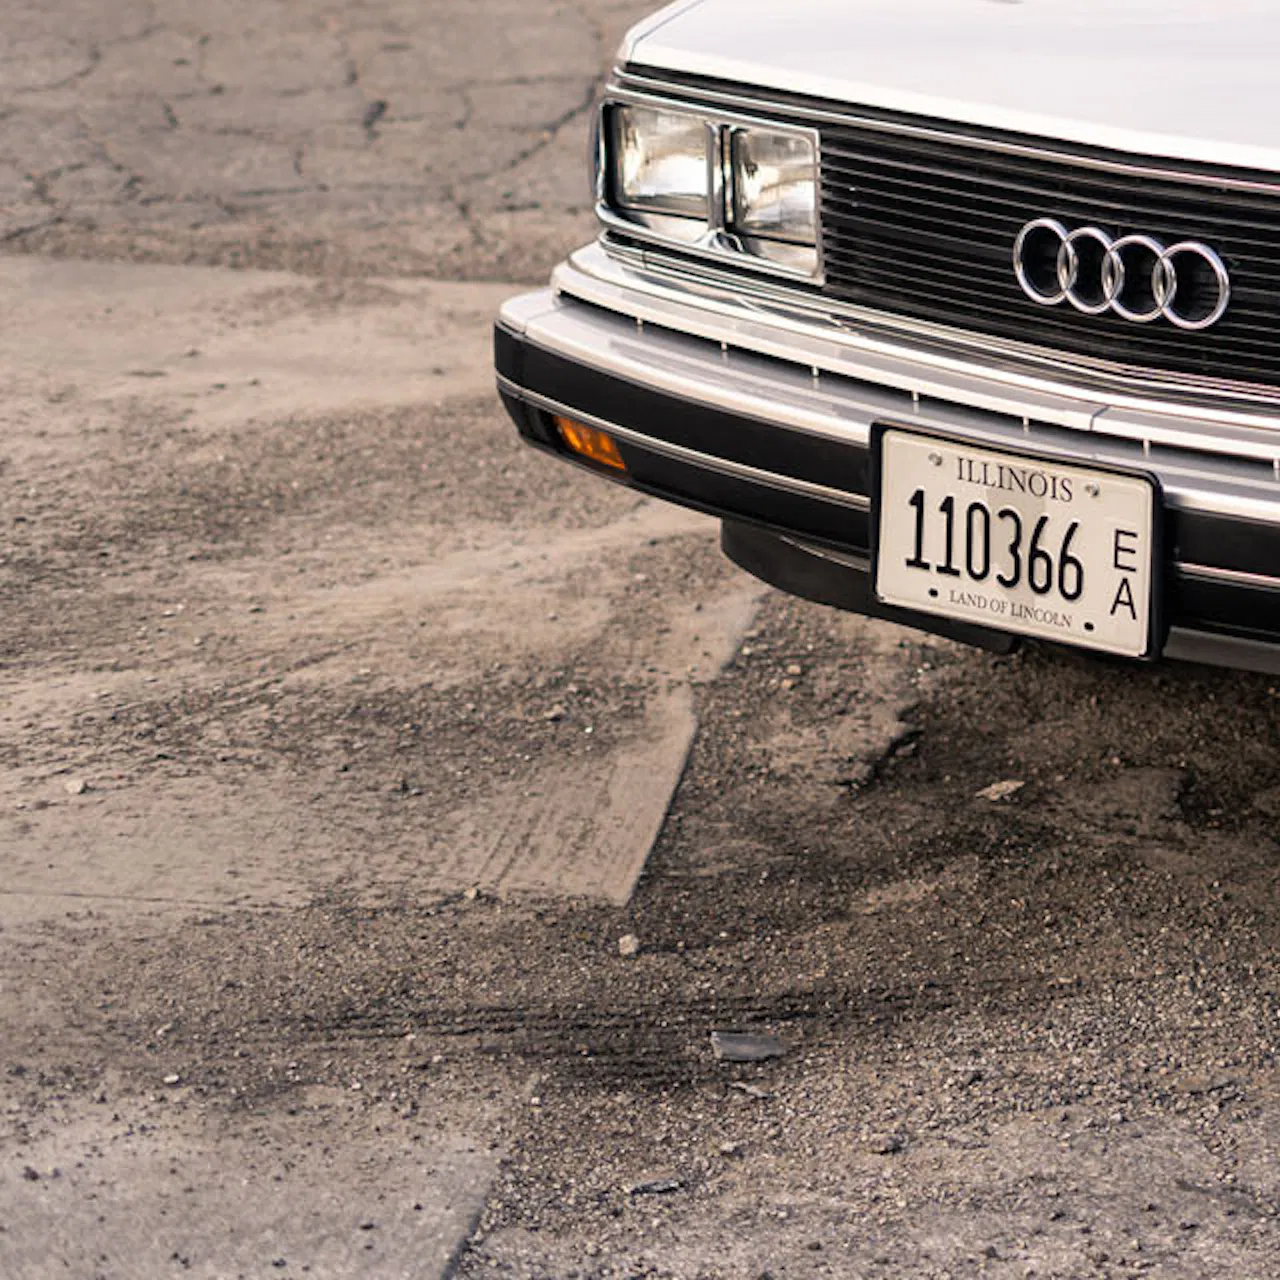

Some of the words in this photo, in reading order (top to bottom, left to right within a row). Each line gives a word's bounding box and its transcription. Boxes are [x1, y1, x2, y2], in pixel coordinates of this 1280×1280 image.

[957, 457, 1073, 503] ILLINOIS
[905, 489, 1084, 600] 110366
[949, 590, 988, 610] LAND
[990, 597, 1009, 614] OF
[1010, 603, 1073, 628] LINCOLN
